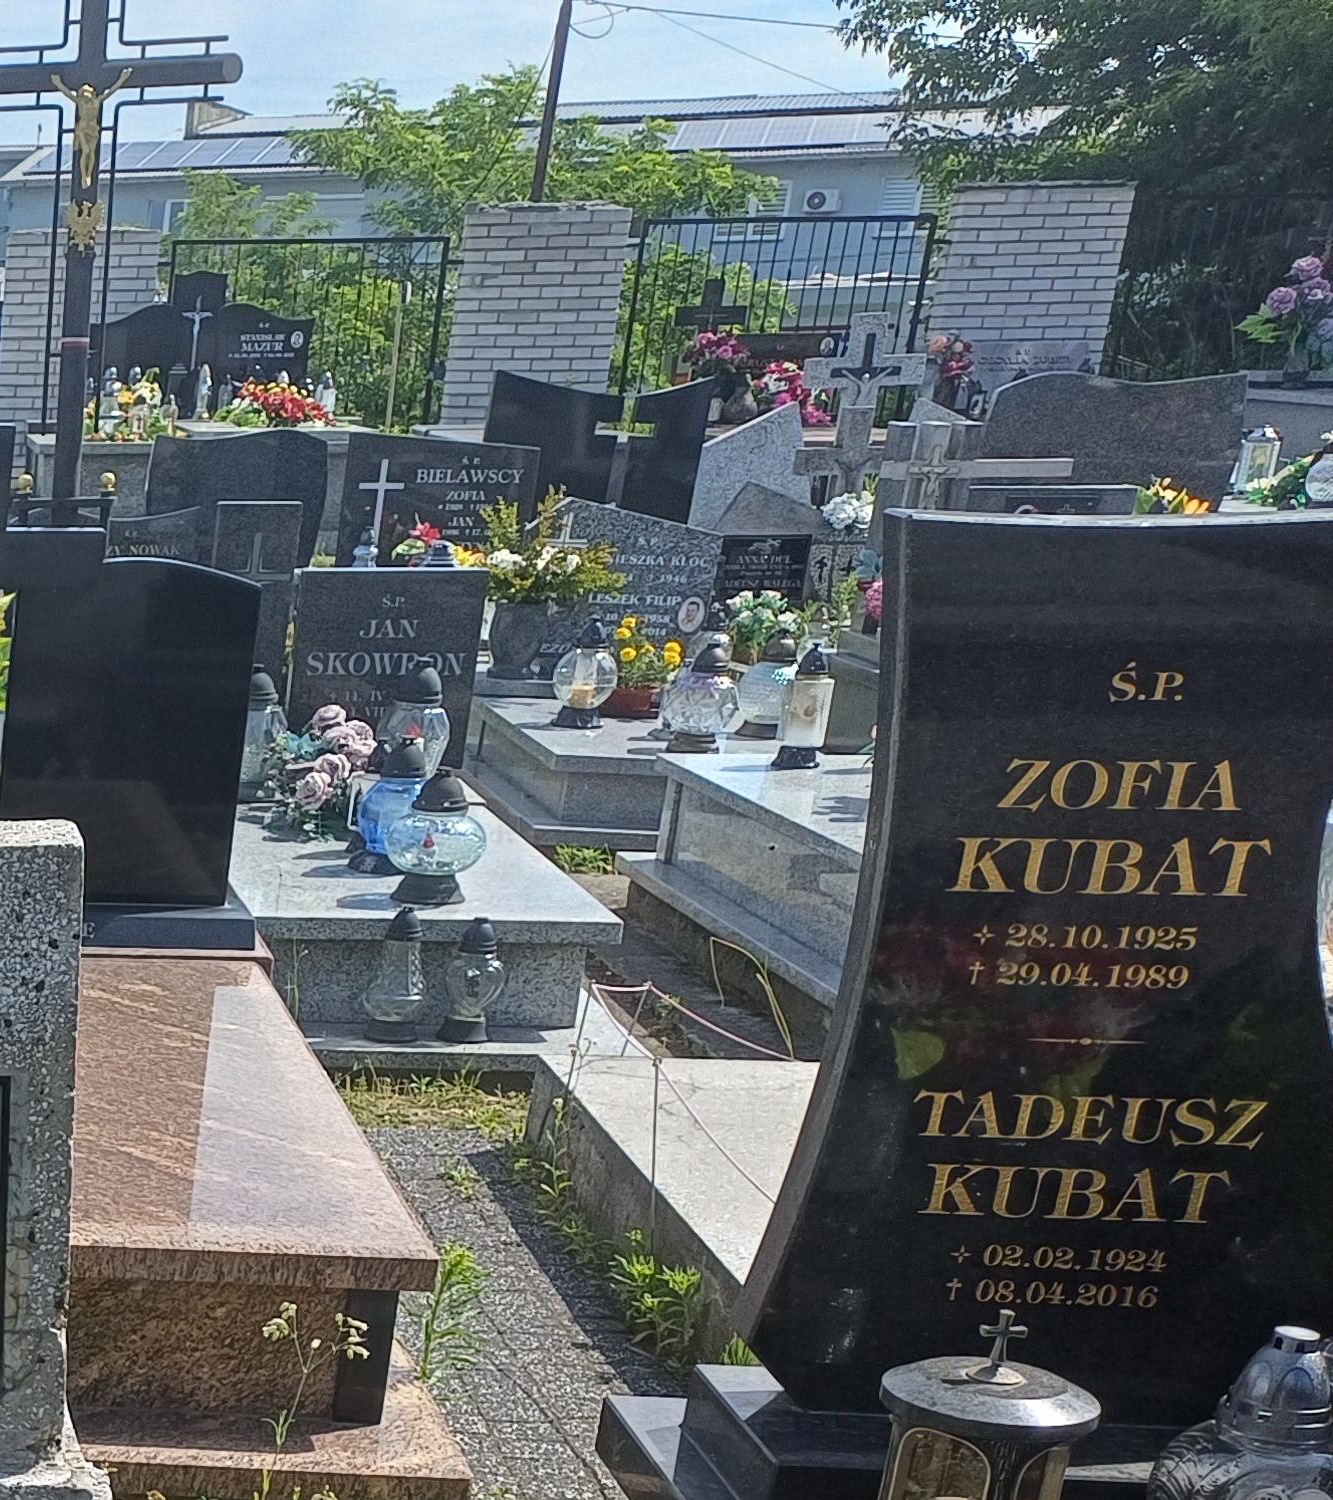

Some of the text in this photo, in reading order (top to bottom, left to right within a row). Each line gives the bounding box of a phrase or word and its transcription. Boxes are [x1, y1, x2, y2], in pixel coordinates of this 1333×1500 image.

[241, 342, 284, 351] MAZUR
[415, 469, 525, 484] BIELAWSCY
[445, 490, 486, 501] ZOFIA
[448, 516, 475, 527] JAN
[129, 544, 180, 556] NOWAK
[588, 593, 682, 607] LESZEK FILIP
[359, 619, 420, 639] JAN
[1108, 661, 1185, 703] Ś.P.
[996, 758, 1243, 812] ZOFIA
[944, 836, 1273, 897] KUBAT
[1004, 923, 1199, 951] 28.10.1925
[996, 961, 1190, 989] 29.04.1989
[913, 1088, 1269, 1151] TADEUSZ
[917, 1163, 1231, 1224] KUBAT
[982, 1244, 1168, 1273] 02.02.1924
[974, 1278, 1160, 1309] 08.04.2016
